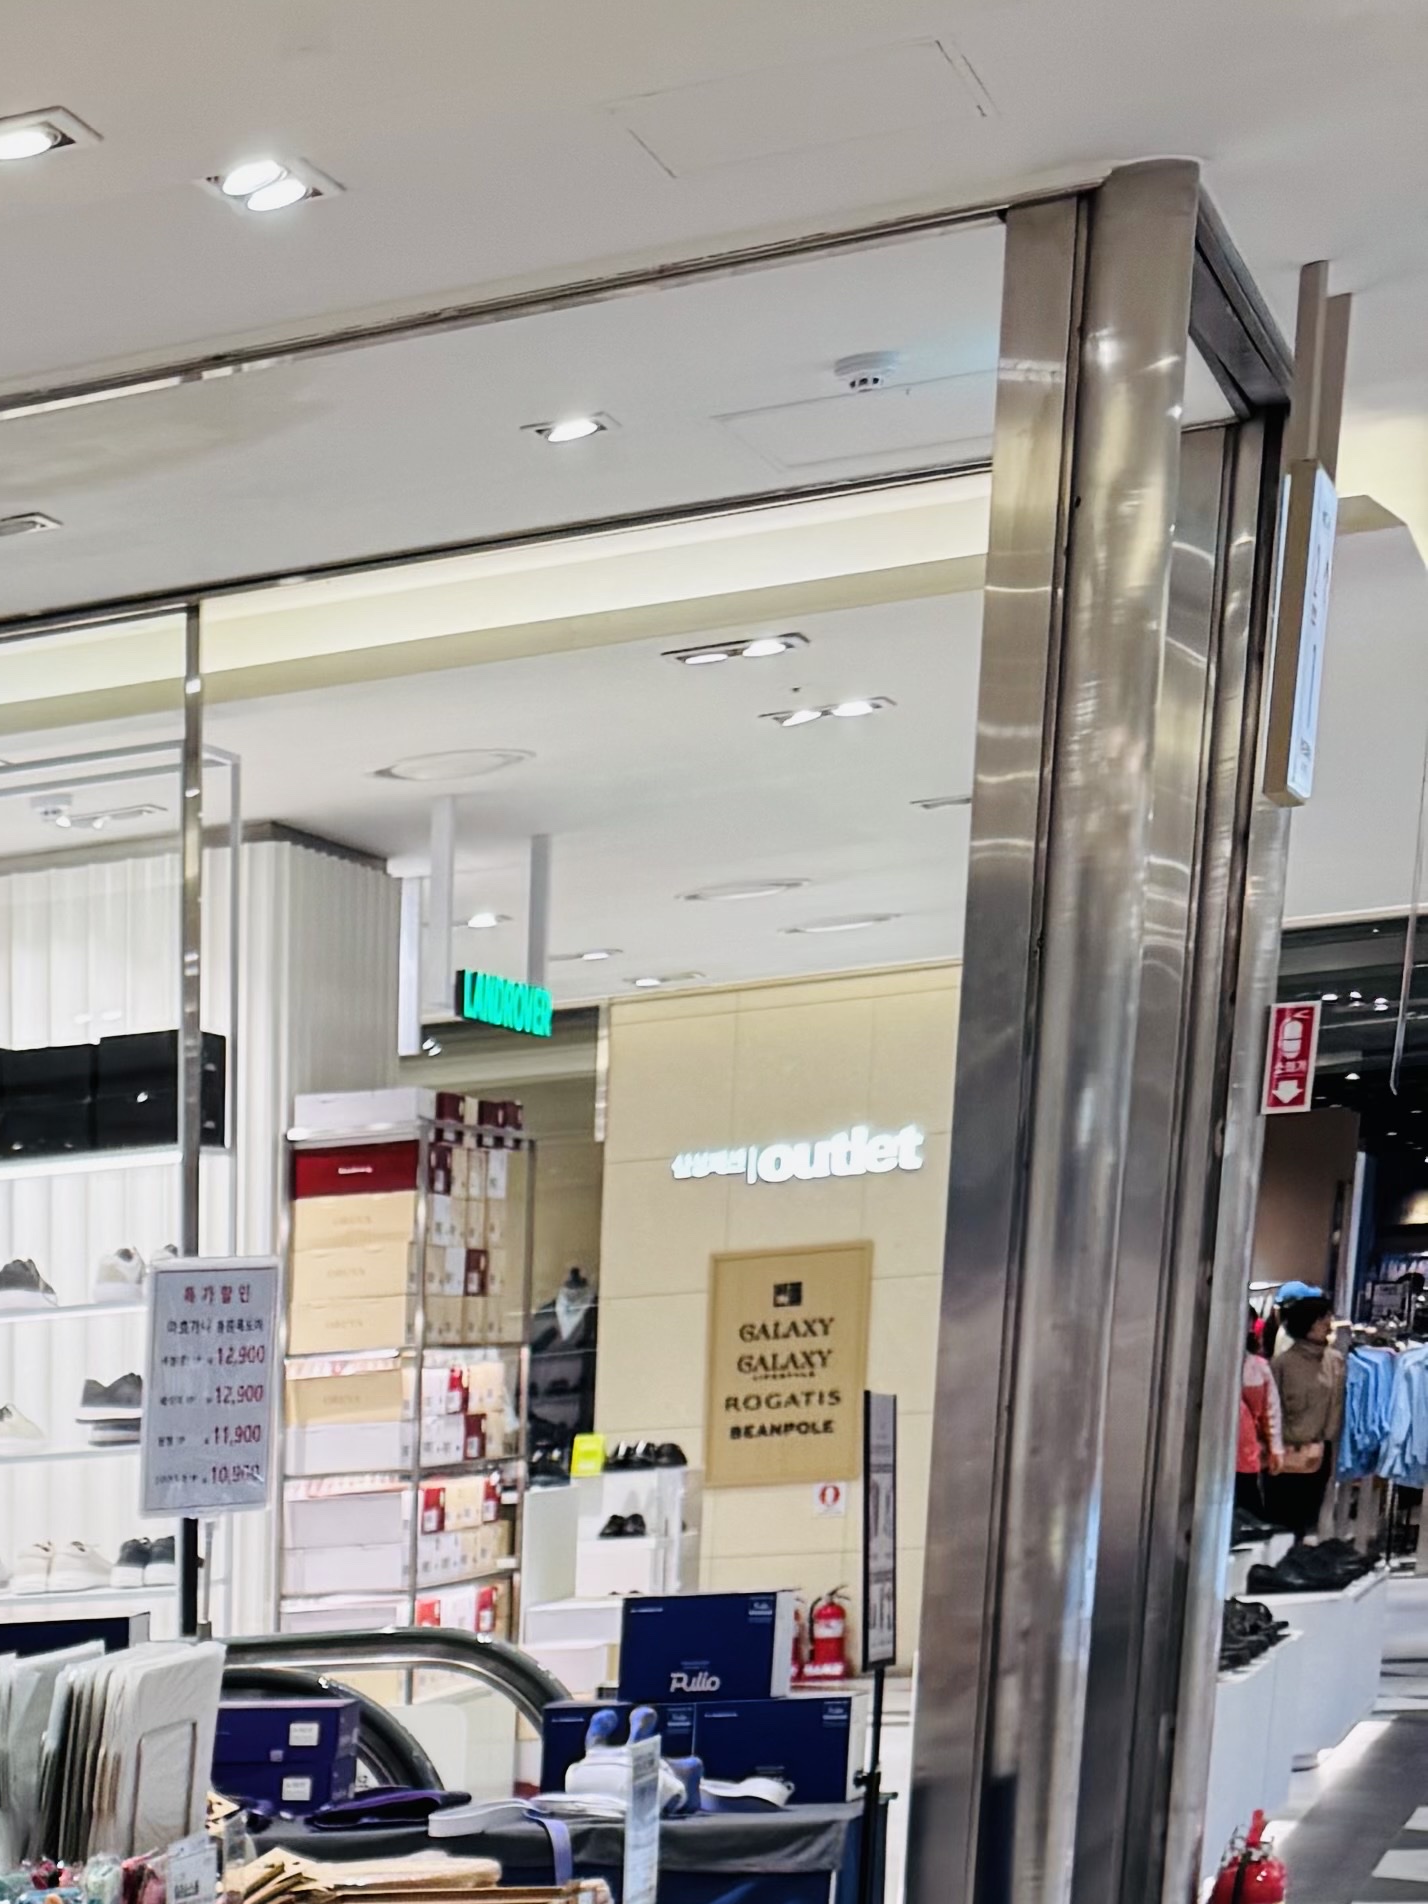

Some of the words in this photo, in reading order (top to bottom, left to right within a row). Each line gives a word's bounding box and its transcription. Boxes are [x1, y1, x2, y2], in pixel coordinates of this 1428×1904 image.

[756, 1123, 924, 1183] outlet
[739, 1317, 835, 1343] GALAXY
[736, 1348, 834, 1373] GALAXY
[724, 1390, 842, 1412] ROGATIS
[730, 1419, 835, 1440] BEANPOLE
[669, 1671, 722, 1693] Pulio
